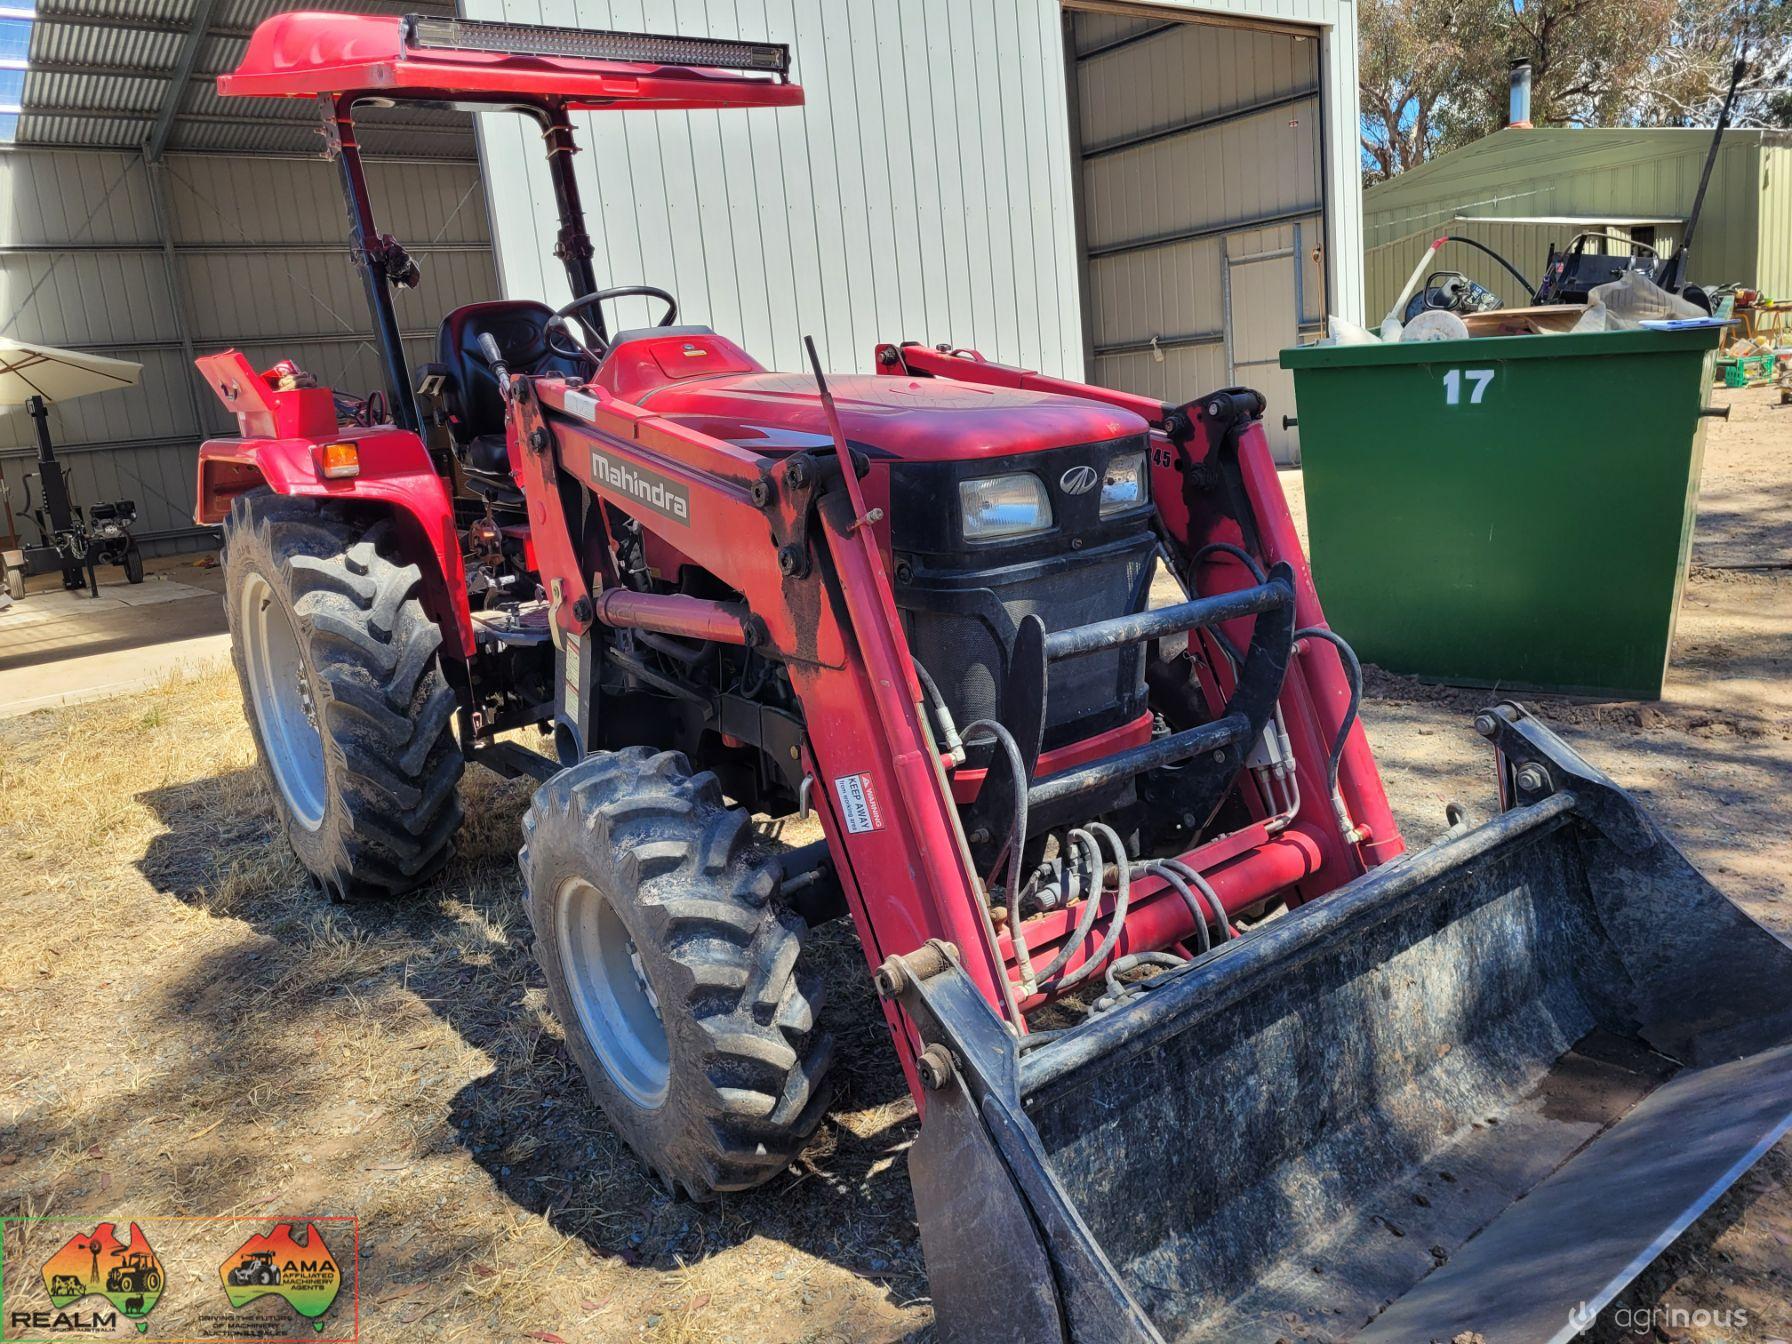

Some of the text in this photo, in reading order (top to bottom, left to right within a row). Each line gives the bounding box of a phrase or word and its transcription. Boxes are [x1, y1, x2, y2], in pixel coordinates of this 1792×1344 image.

[1443, 369, 1495, 405] 17
[1150, 447, 1171, 469] 45
[592, 452, 688, 519] Mahindra
[849, 777, 869, 829] KEEP AWAY
[866, 788, 882, 828] WARNING
